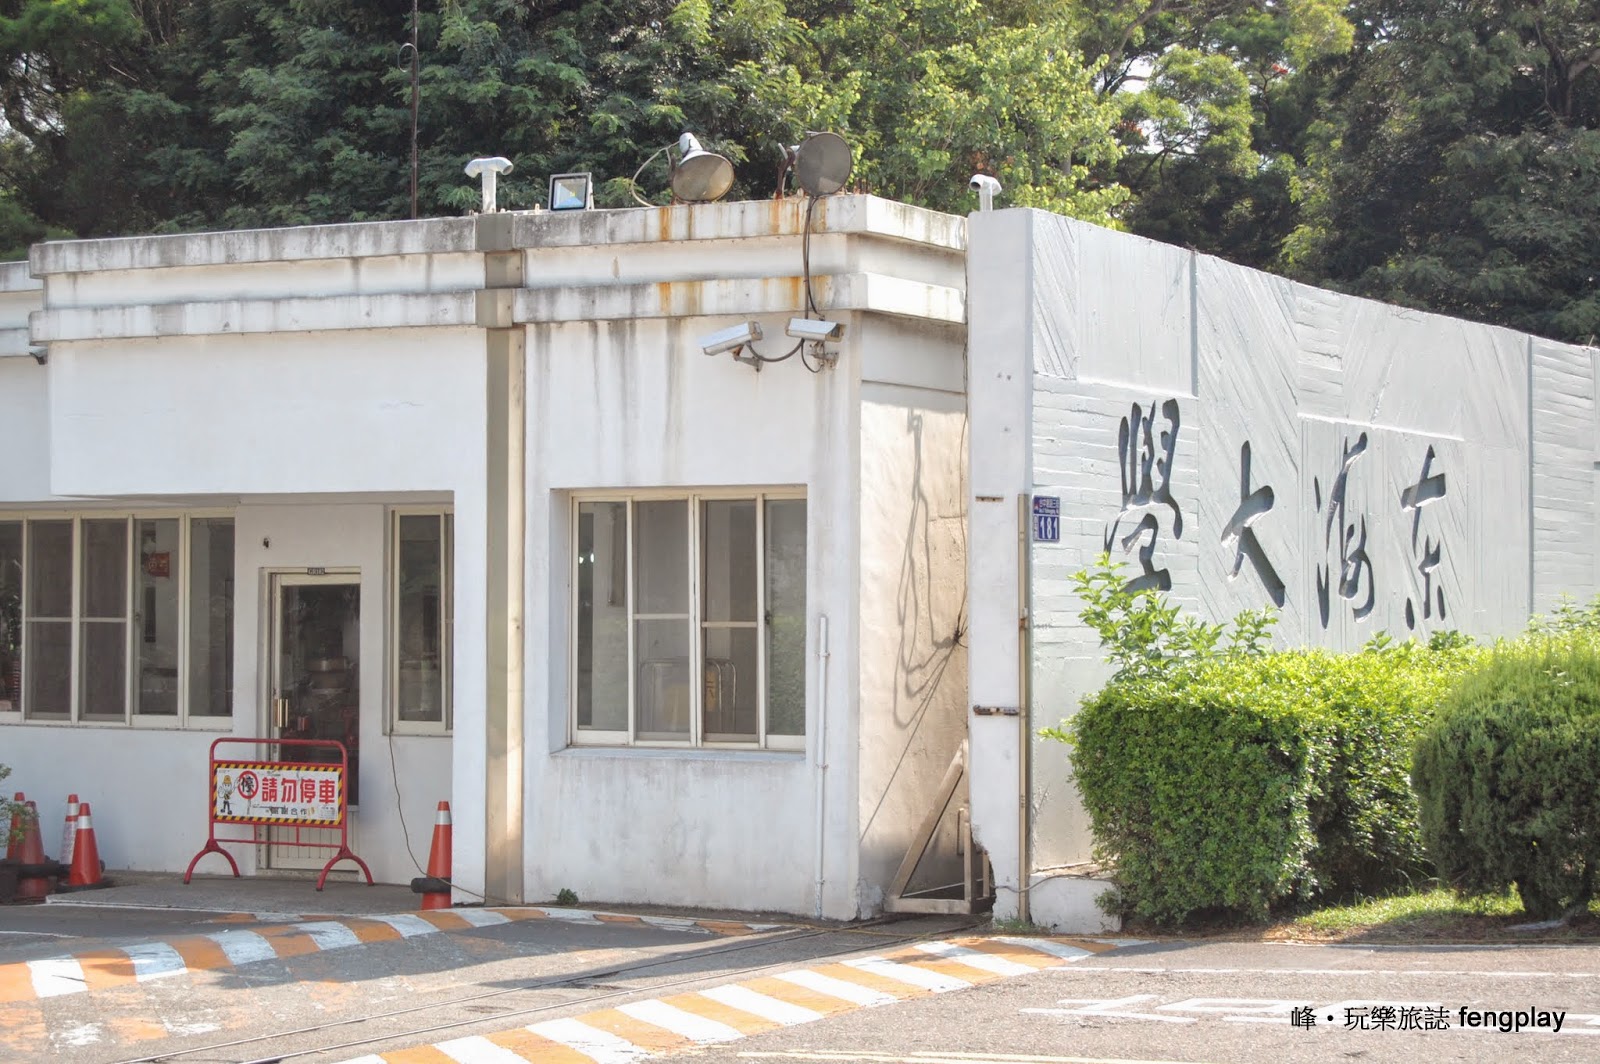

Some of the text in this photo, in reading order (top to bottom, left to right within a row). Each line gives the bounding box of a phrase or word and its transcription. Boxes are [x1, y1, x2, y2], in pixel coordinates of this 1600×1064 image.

[1039, 516, 1058, 539] 181
[261, 777, 336, 804] 請勿停車
